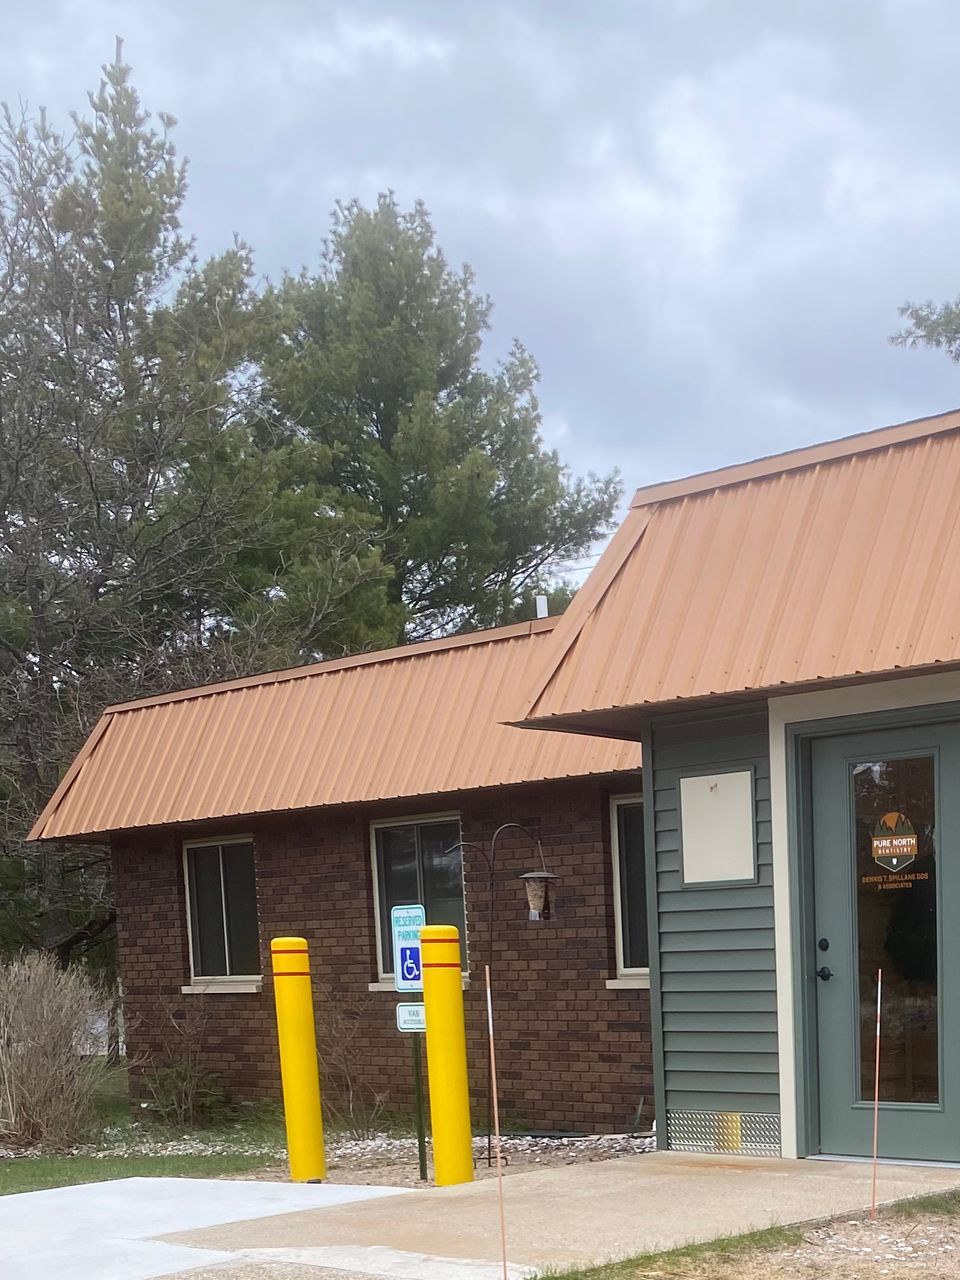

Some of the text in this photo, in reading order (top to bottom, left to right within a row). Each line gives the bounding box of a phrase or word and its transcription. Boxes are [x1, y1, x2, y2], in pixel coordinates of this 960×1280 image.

[873, 837, 916, 848] PURE NORTH
[878, 847, 911, 855] DENTISTRY
[394, 915, 424, 927] RESERVED
[408, 1009, 420, 1018] VAN
